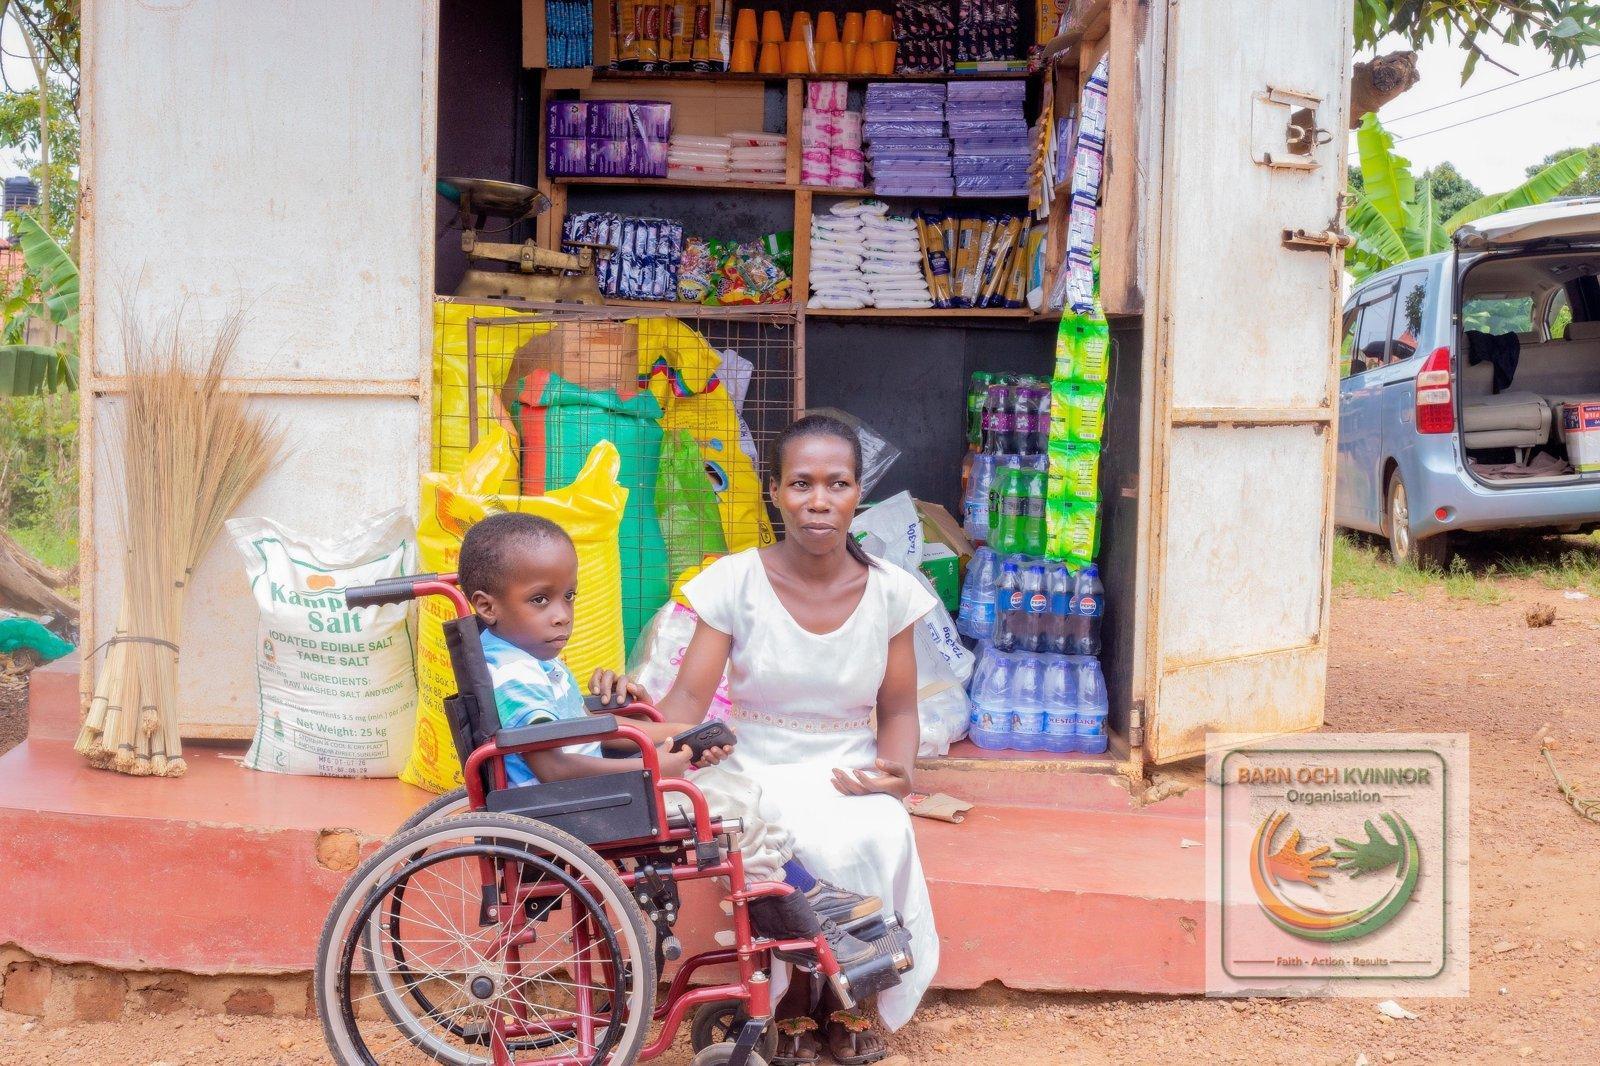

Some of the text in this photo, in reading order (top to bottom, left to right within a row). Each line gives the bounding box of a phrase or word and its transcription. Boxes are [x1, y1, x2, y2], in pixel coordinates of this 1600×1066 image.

[270, 581, 344, 613] Kamp
[307, 611, 363, 634] Salt
[269, 630, 394, 653] IODATED EDIBLE SALT
[297, 650, 369, 667] TABLE SALT
[300, 671, 371, 686] INGREDIENTS:
[302, 684, 338, 697] WASHED
[340, 690, 361, 698] SALT
[364, 689, 381, 698] AND
[341, 713, 354, 721] 3.5
[355, 715, 367, 723] mg
[297, 718, 387, 738] Net Weight: 25 kg
